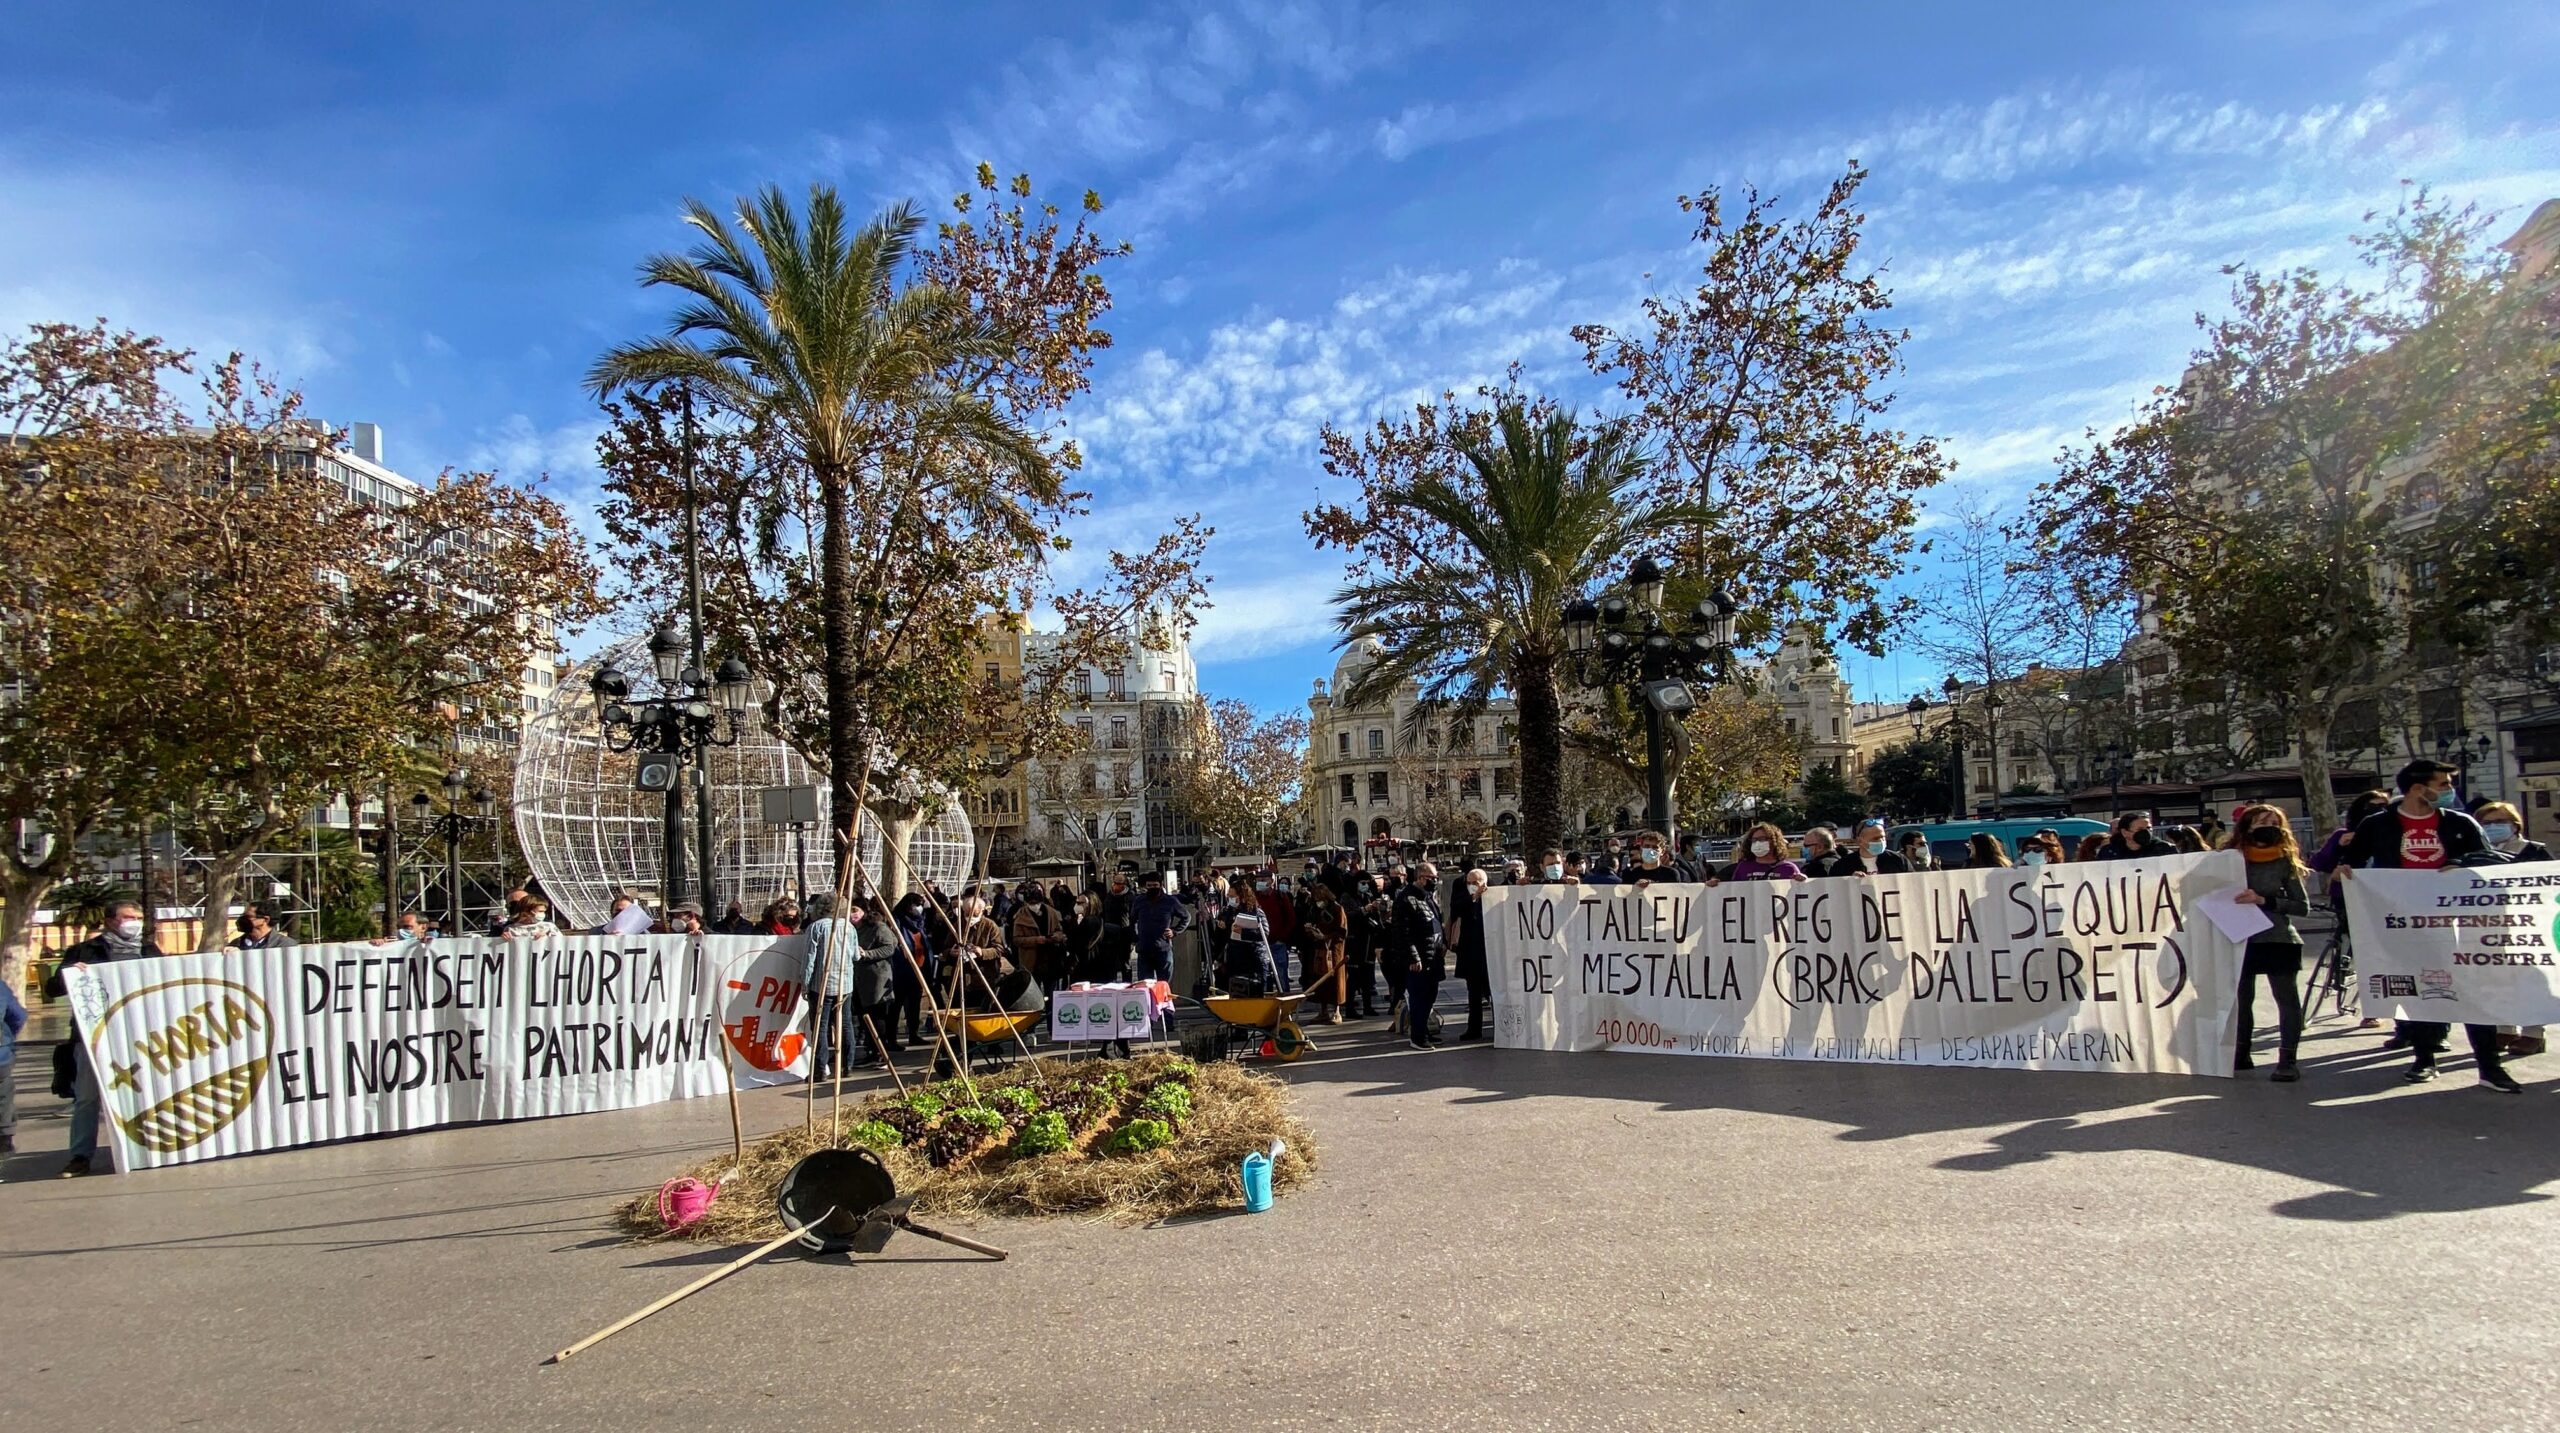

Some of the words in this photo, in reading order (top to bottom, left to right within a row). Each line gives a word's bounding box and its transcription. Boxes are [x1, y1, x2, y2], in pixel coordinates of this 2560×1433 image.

[1518, 899, 1554, 940] NO
[1580, 896, 1690, 943] TALLEU
[1722, 896, 1756, 943] EL
[1771, 894, 1832, 943] REG
[1861, 890, 1904, 943] DE
[1934, 888, 1979, 943] LA
[2410, 914, 2536, 929] DEFENSAR
[2437, 893, 2544, 907] L'HORTA
[2453, 952, 2556, 966] NOSTRA
[2480, 934, 2546, 947] CASA
[303, 953, 504, 1015] DEFENSEM
[530, 947, 665, 1007] L'HORTA
[1522, 955, 1553, 994] DE
[1582, 953, 1742, 1000] MESTALLA
[1773, 947, 1884, 1010] (BRAÇ
[1911, 935, 2187, 1008] D'ALEGRET)
[135, 994, 261, 1076] HORTA
[1595, 1019, 1661, 1047] 40.000
[1690, 1032, 1752, 1055] D'HORTA
[1772, 1036, 1794, 1057] EN
[1814, 1036, 1921, 1061] BENIMACLET
[277, 1049, 329, 1105] EL
[346, 1029, 485, 1097] NOSTRE
